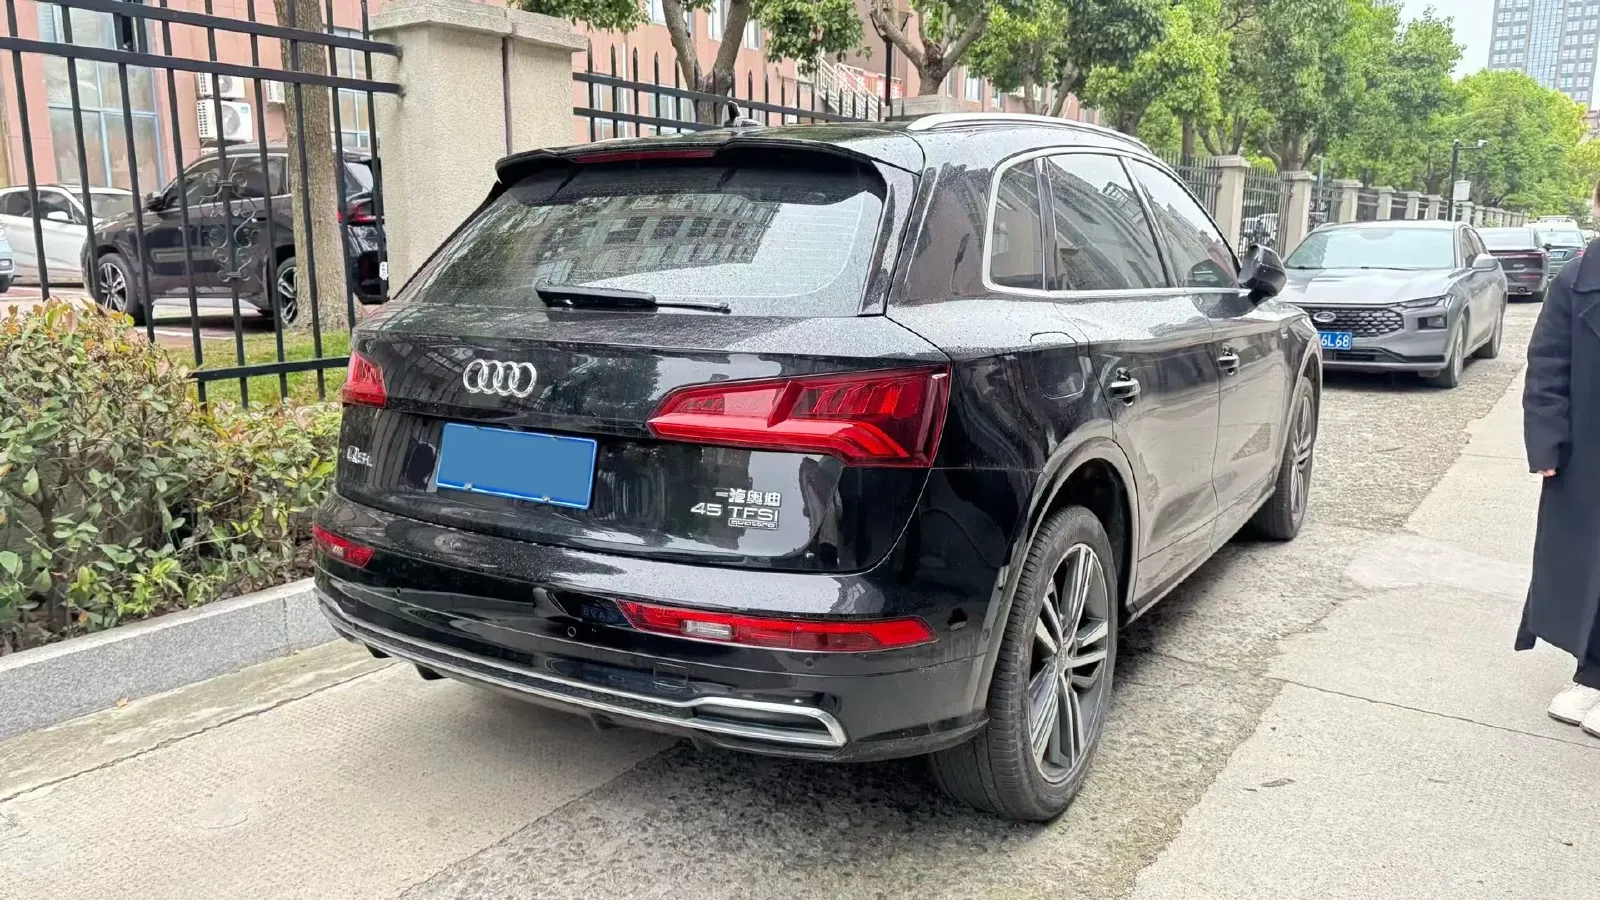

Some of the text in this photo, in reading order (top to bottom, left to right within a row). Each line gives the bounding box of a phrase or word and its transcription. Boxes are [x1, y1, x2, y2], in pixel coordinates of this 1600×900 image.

[1318, 333, 1350, 347] 6L68
[715, 488, 781, 507] 一汽奥迪
[690, 502, 779, 522] 45 TFSI
[730, 520, 776, 528] quattro
